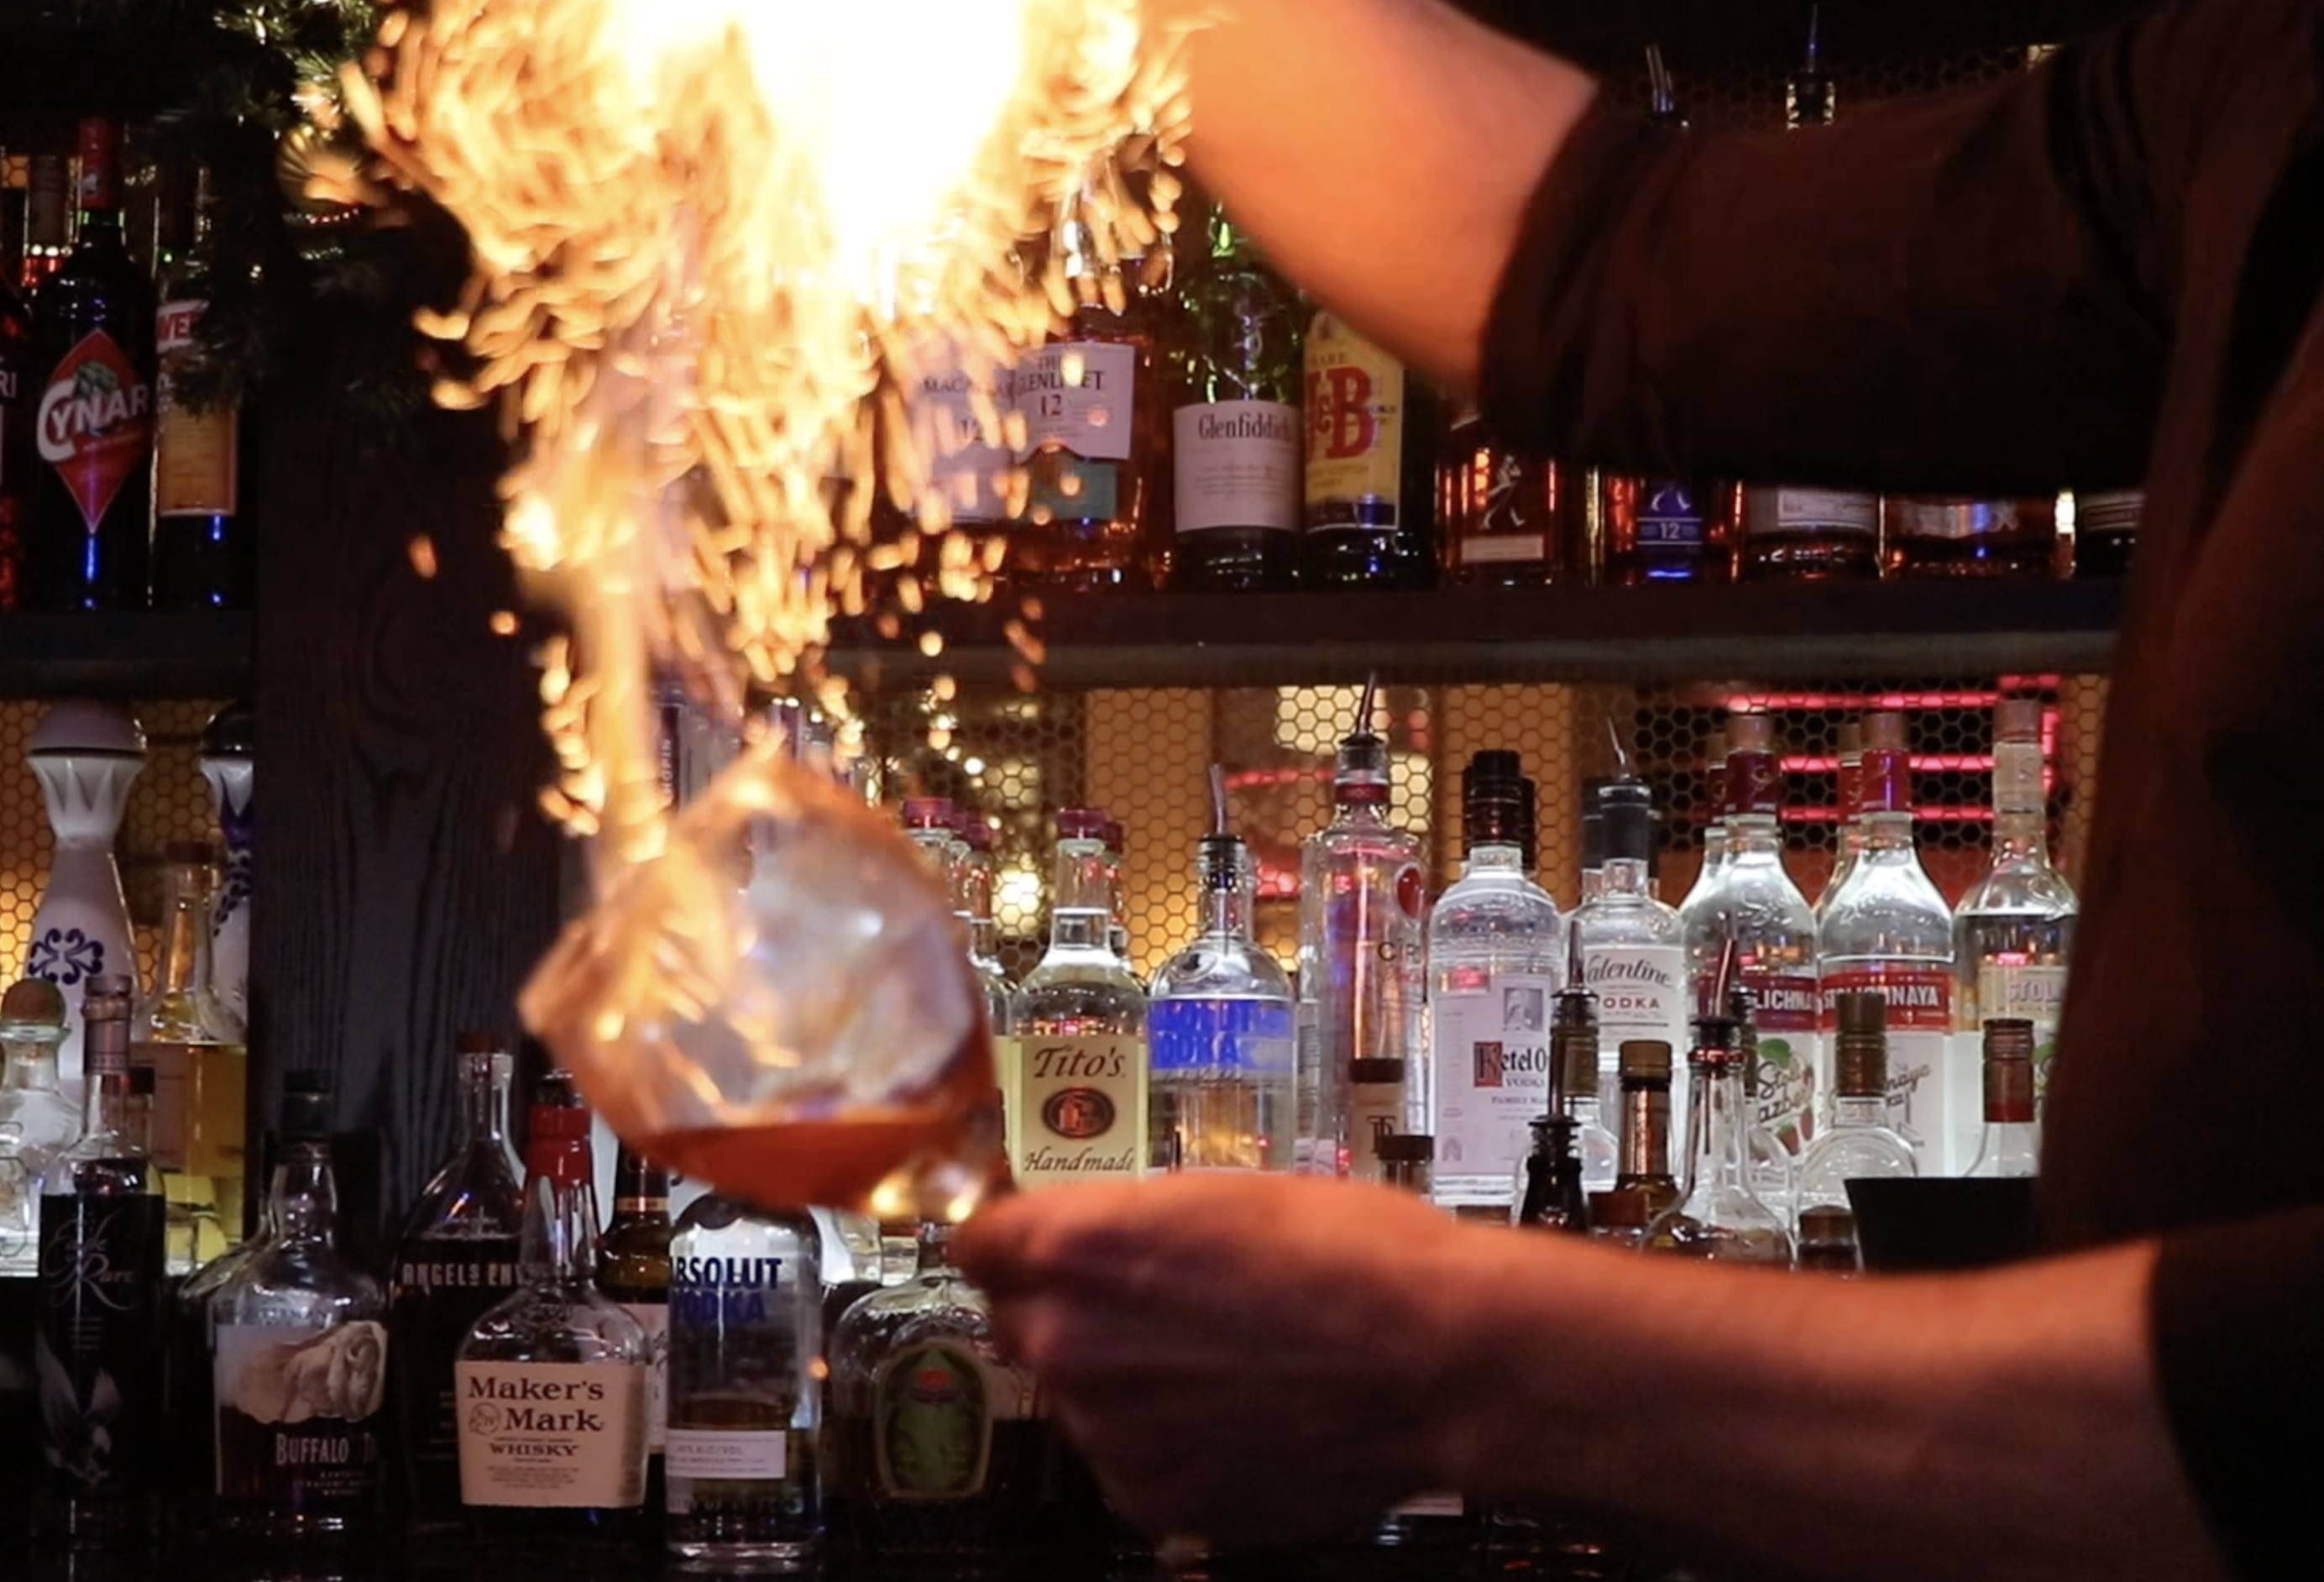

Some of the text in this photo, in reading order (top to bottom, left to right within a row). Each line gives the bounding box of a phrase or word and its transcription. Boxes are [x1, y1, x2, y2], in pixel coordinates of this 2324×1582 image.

[1040, 394, 1063, 416] 12
[37, 378, 149, 462] CYNAR
[1660, 521, 1680, 539] 12
[1597, 997, 1659, 1008] ODKA
[1034, 1045, 1125, 1078] Tito's
[672, 1256, 782, 1289] BSOLUT
[467, 1376, 605, 1401] Maker's
[505, 1407, 604, 1433] Mark
[275, 1433, 350, 1465] BUFFALO
[489, 1443, 579, 1457] WHISKY
